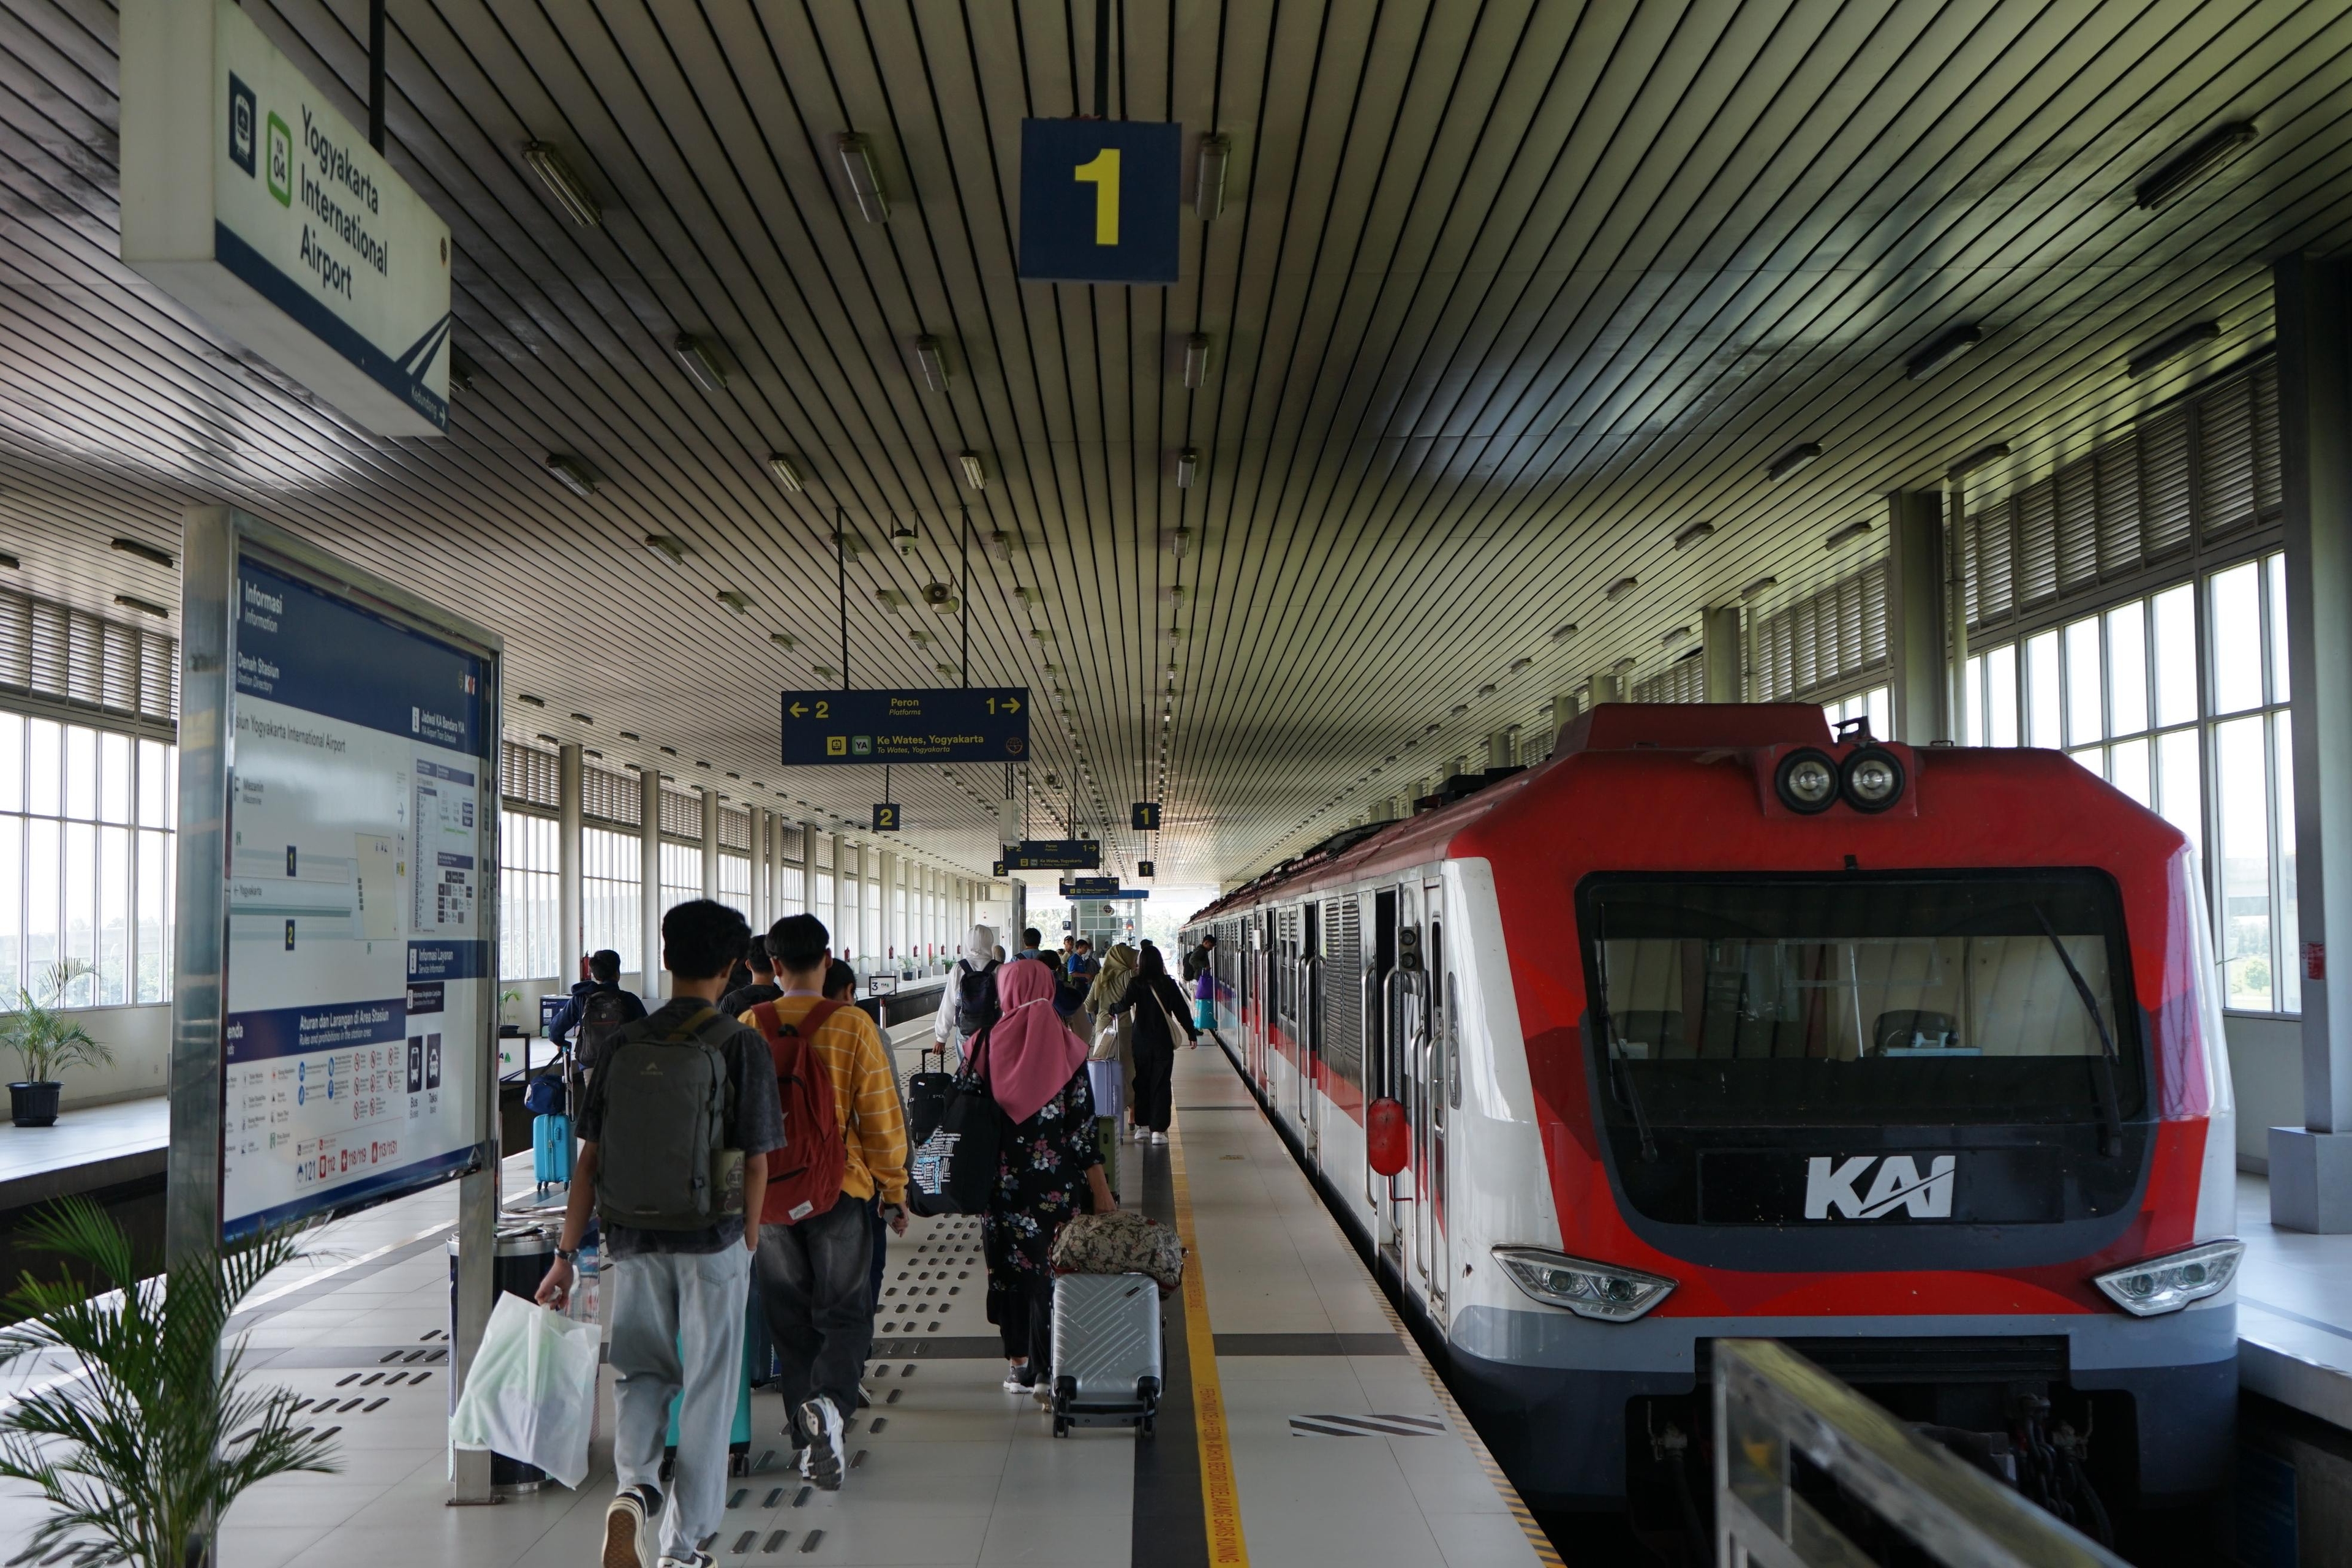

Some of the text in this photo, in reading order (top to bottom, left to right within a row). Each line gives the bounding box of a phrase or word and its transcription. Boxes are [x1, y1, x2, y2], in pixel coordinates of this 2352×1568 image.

[276, 137, 284, 155] YA
[274, 154, 285, 183] 04
[302, 103, 379, 215] Yogyakarta
[1075, 148, 1120, 245] 1
[301, 163, 388, 277] International
[300, 224, 352, 301] Airport
[246, 581, 282, 614] Informasi
[245, 607, 277, 633] Information
[238, 650, 279, 679] Denah Stasiun
[815, 701, 829, 718] 2
[891, 698, 919, 707] Peron
[986, 697, 995, 714] 1
[250, 714, 286, 739] Yogyakarta
[287, 723, 325, 748] International
[325, 734, 346, 755] Airport
[877, 736, 889, 745] Ke
[892, 736, 926, 745] Wates,
[929, 734, 984, 745] Yogyakarta
[880, 809, 892, 826] 2
[1140, 808, 1149, 824] 1
[289, 853, 293, 871] 1
[997, 864, 1005, 875] 2
[1143, 864, 1148, 874] 1
[288, 926, 293, 944] 2
[419, 948, 453, 963] Informasi Layanan
[300, 1008, 389, 1030] Aturan dan Larangan di Area Stasiun
[429, 1092, 437, 1103] Taksi
[327, 1156, 336, 1172] 112
[349, 1147, 366, 1167] 118/119
[305, 1159, 315, 1182] 121
[1805, 1155, 1955, 1219] KAI
[1208, 1462, 1227, 1482] BERDIRI
[1214, 1518, 1235, 1536] GARIS
[1216, 1538, 1240, 1563] KUNING
